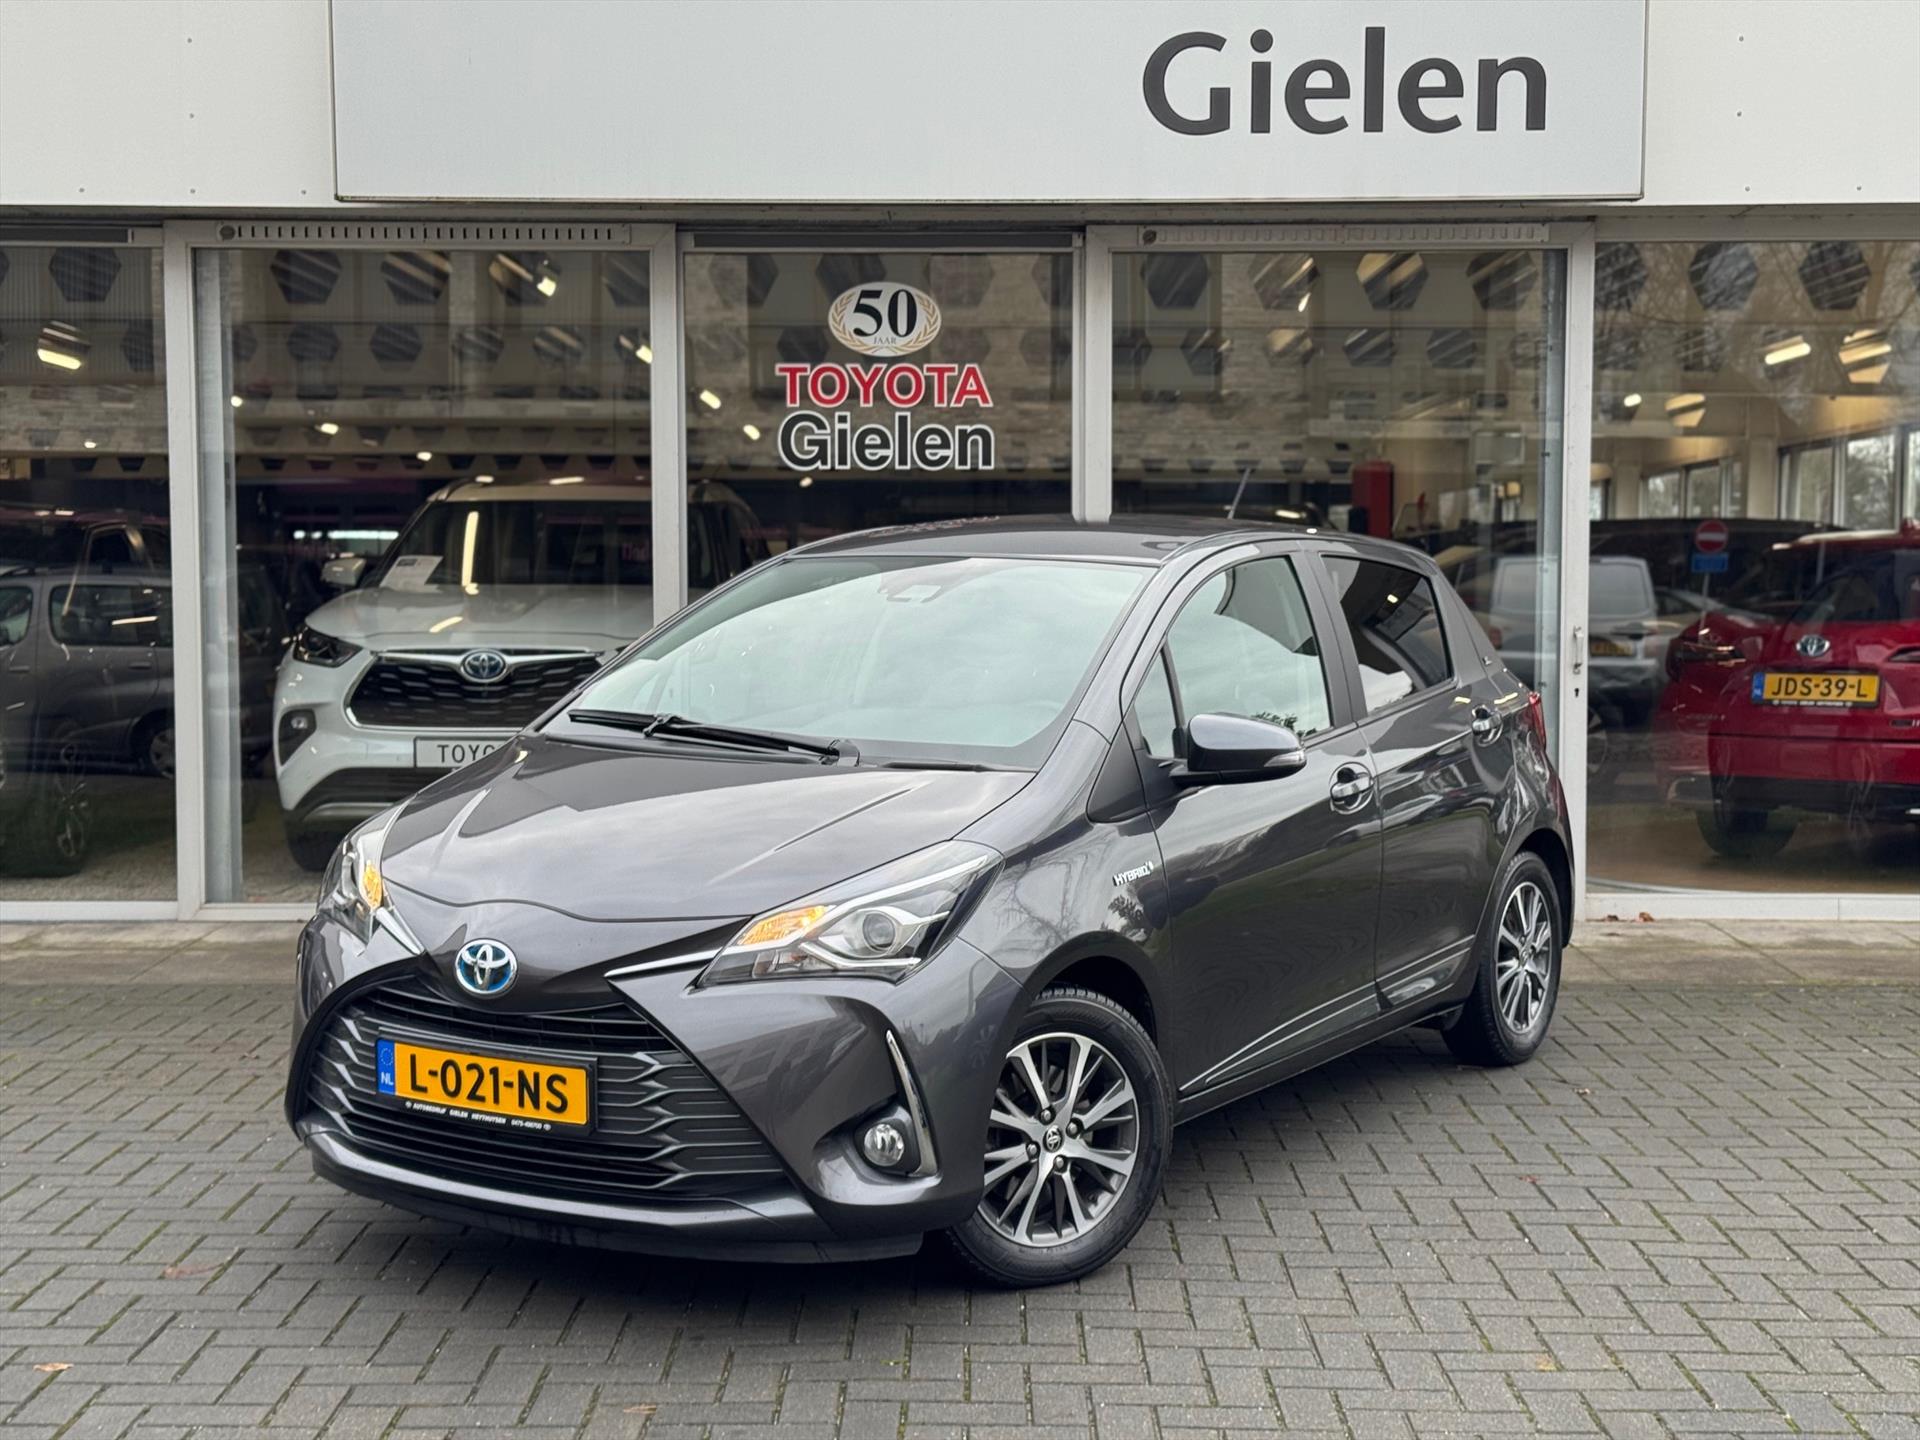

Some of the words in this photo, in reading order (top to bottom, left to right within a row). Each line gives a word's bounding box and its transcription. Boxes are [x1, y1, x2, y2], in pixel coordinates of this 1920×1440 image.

[1142, 26, 1547, 136] Gielen
[852, 289, 918, 337] 50
[873, 336, 897, 346] JAAR
[775, 363, 994, 408] TOYOTA
[778, 410, 995, 471] Gielen
[1771, 677, 1868, 698] JDS-39-L
[380, 1071, 394, 1086] NL
[409, 1053, 569, 1114] L-021-NS
